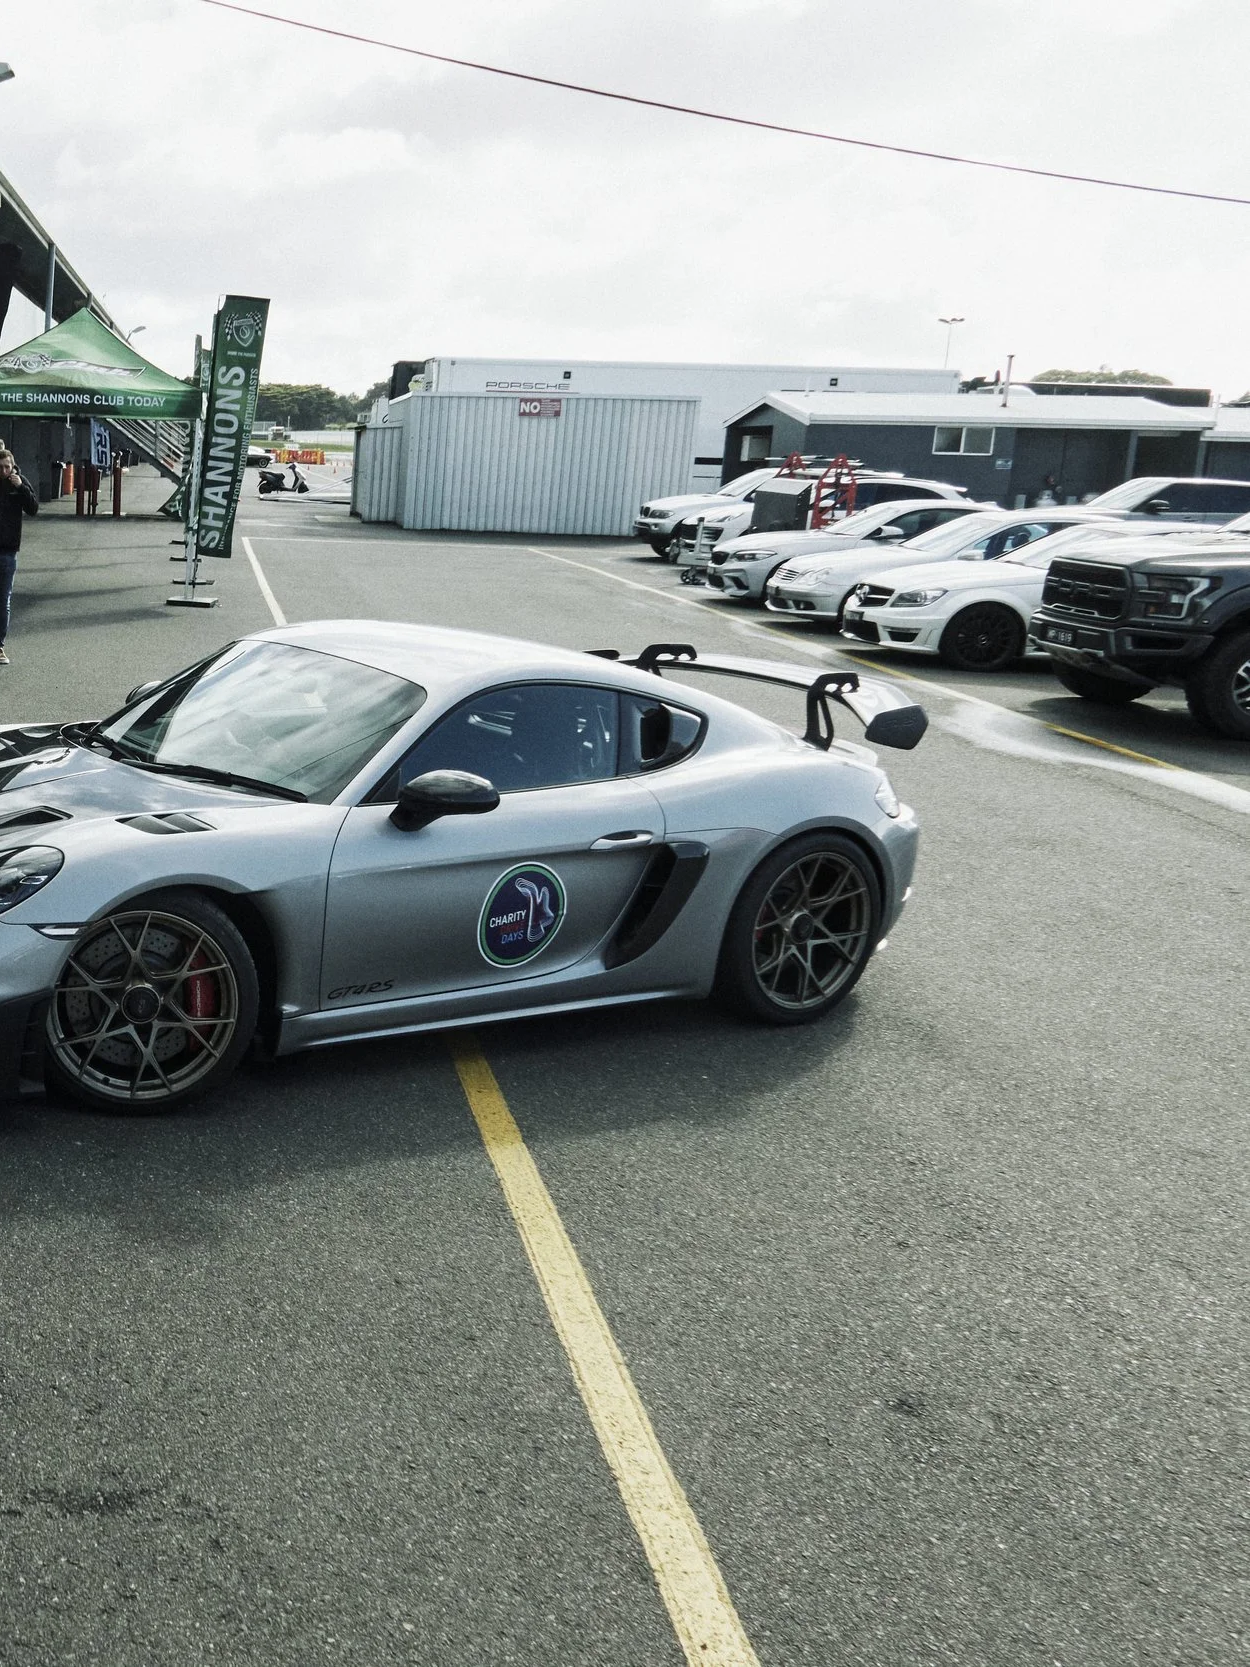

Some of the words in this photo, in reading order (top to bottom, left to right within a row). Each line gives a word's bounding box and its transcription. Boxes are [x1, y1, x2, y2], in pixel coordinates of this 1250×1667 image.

[485, 381, 570, 390] PORSCHE
[0, 393, 23, 403] THE
[26, 393, 91, 405] SHANNONS
[93, 394, 124, 406] CLUB
[127, 395, 166, 407] TODAY
[243, 368, 259, 431] ENTHUSIASTS
[519, 401, 541, 414] NO
[198, 366, 245, 549] SHANNONS
[236, 432, 251, 480] MOTORING
[232, 482, 242, 500] FOR
[489, 909, 527, 928] CHARITY
[501, 930, 524, 944] DAYS
